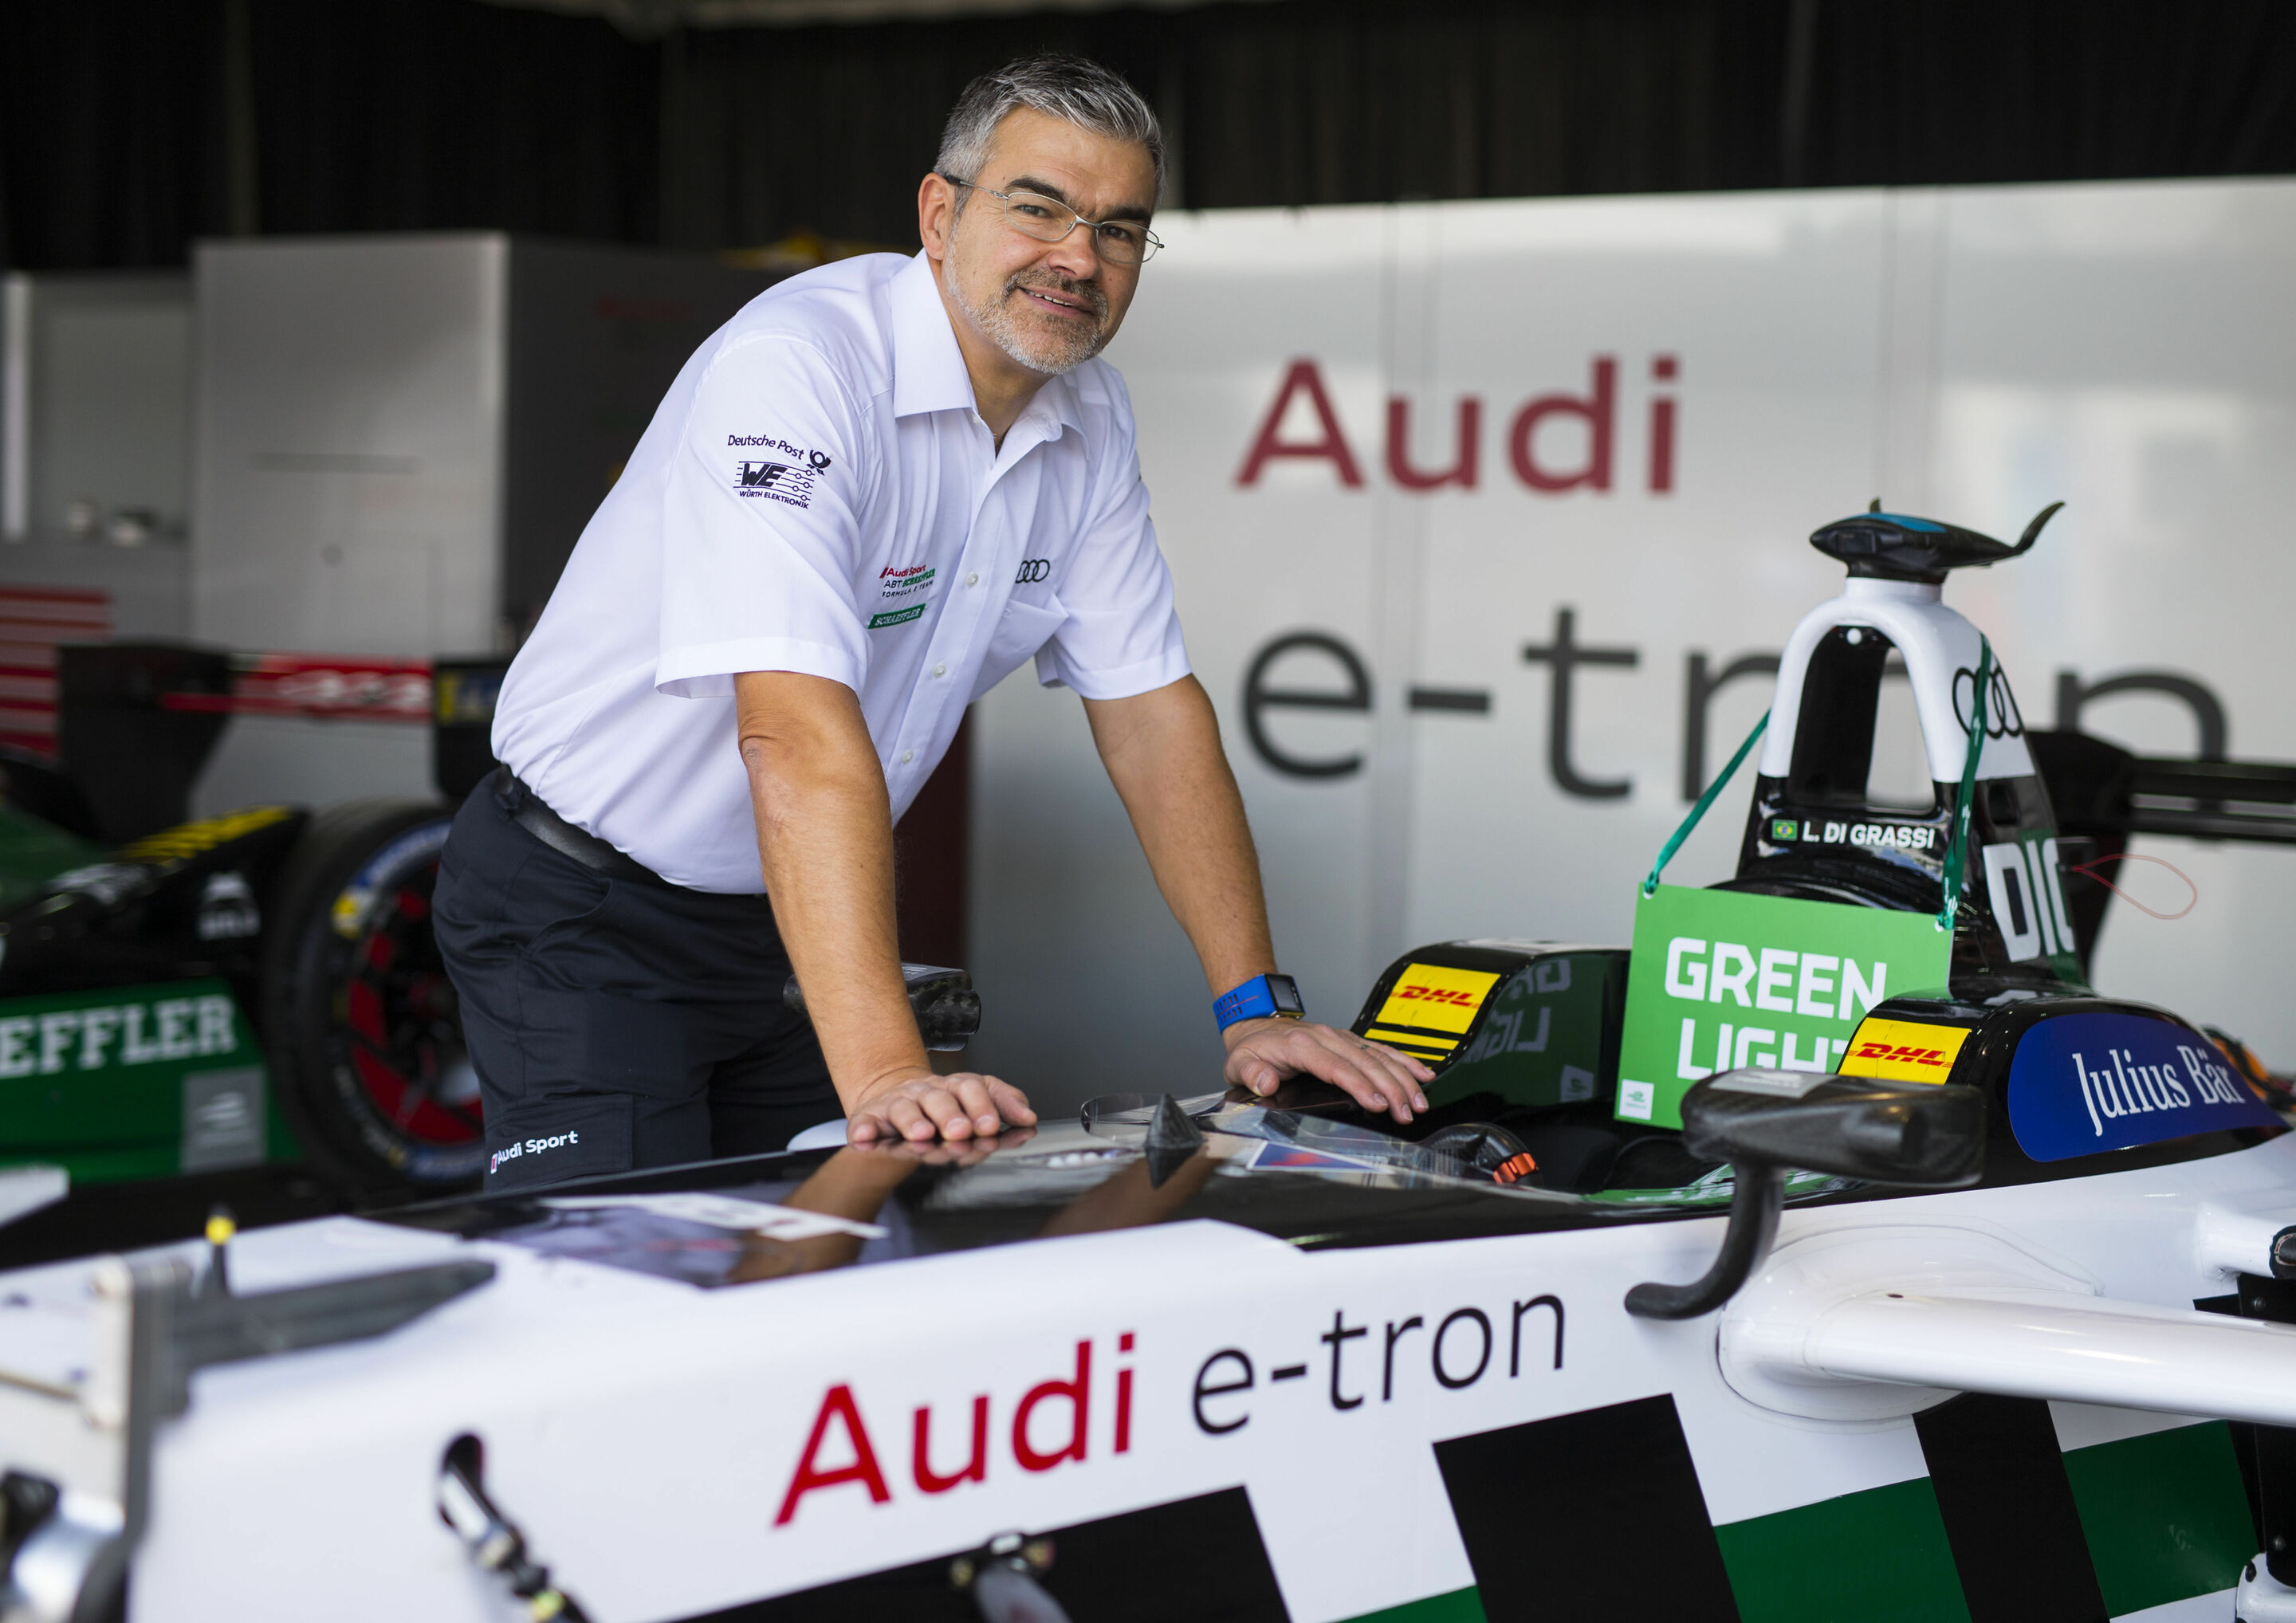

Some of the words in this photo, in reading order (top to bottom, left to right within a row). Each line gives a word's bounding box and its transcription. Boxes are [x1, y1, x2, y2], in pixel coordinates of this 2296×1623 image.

[1234, 352, 1681, 497] Audi
[728, 434, 776, 447] Deutsche
[777, 440, 804, 460] Post
[741, 463, 788, 487] WE
[739, 489, 763, 497] WÜRTH
[764, 492, 809, 509] ELEKTRONIK
[886, 568, 909, 577] Audi
[909, 564, 926, 576] Sport
[882, 588, 911, 598] FORMULA
[919, 580, 934, 591] TEAM
[1802, 821, 1820, 842] L.
[1823, 822, 1848, 843] DI
[1850, 823, 1935, 849] GRASSI
[1665, 937, 1887, 1020] GREEN
[1398, 985, 1474, 1007] DHL
[0, 993, 237, 1079] EFFLER
[1855, 1042, 1946, 1067] DHL
[2072, 1048, 2191, 1137] Julius
[2176, 1045, 2246, 1104] Bär
[497, 1142, 522, 1165] Audi
[525, 1130, 579, 1154] Sport
[771, 1330, 1135, 1529] Audi
[1190, 1291, 1565, 1436] e-tron
